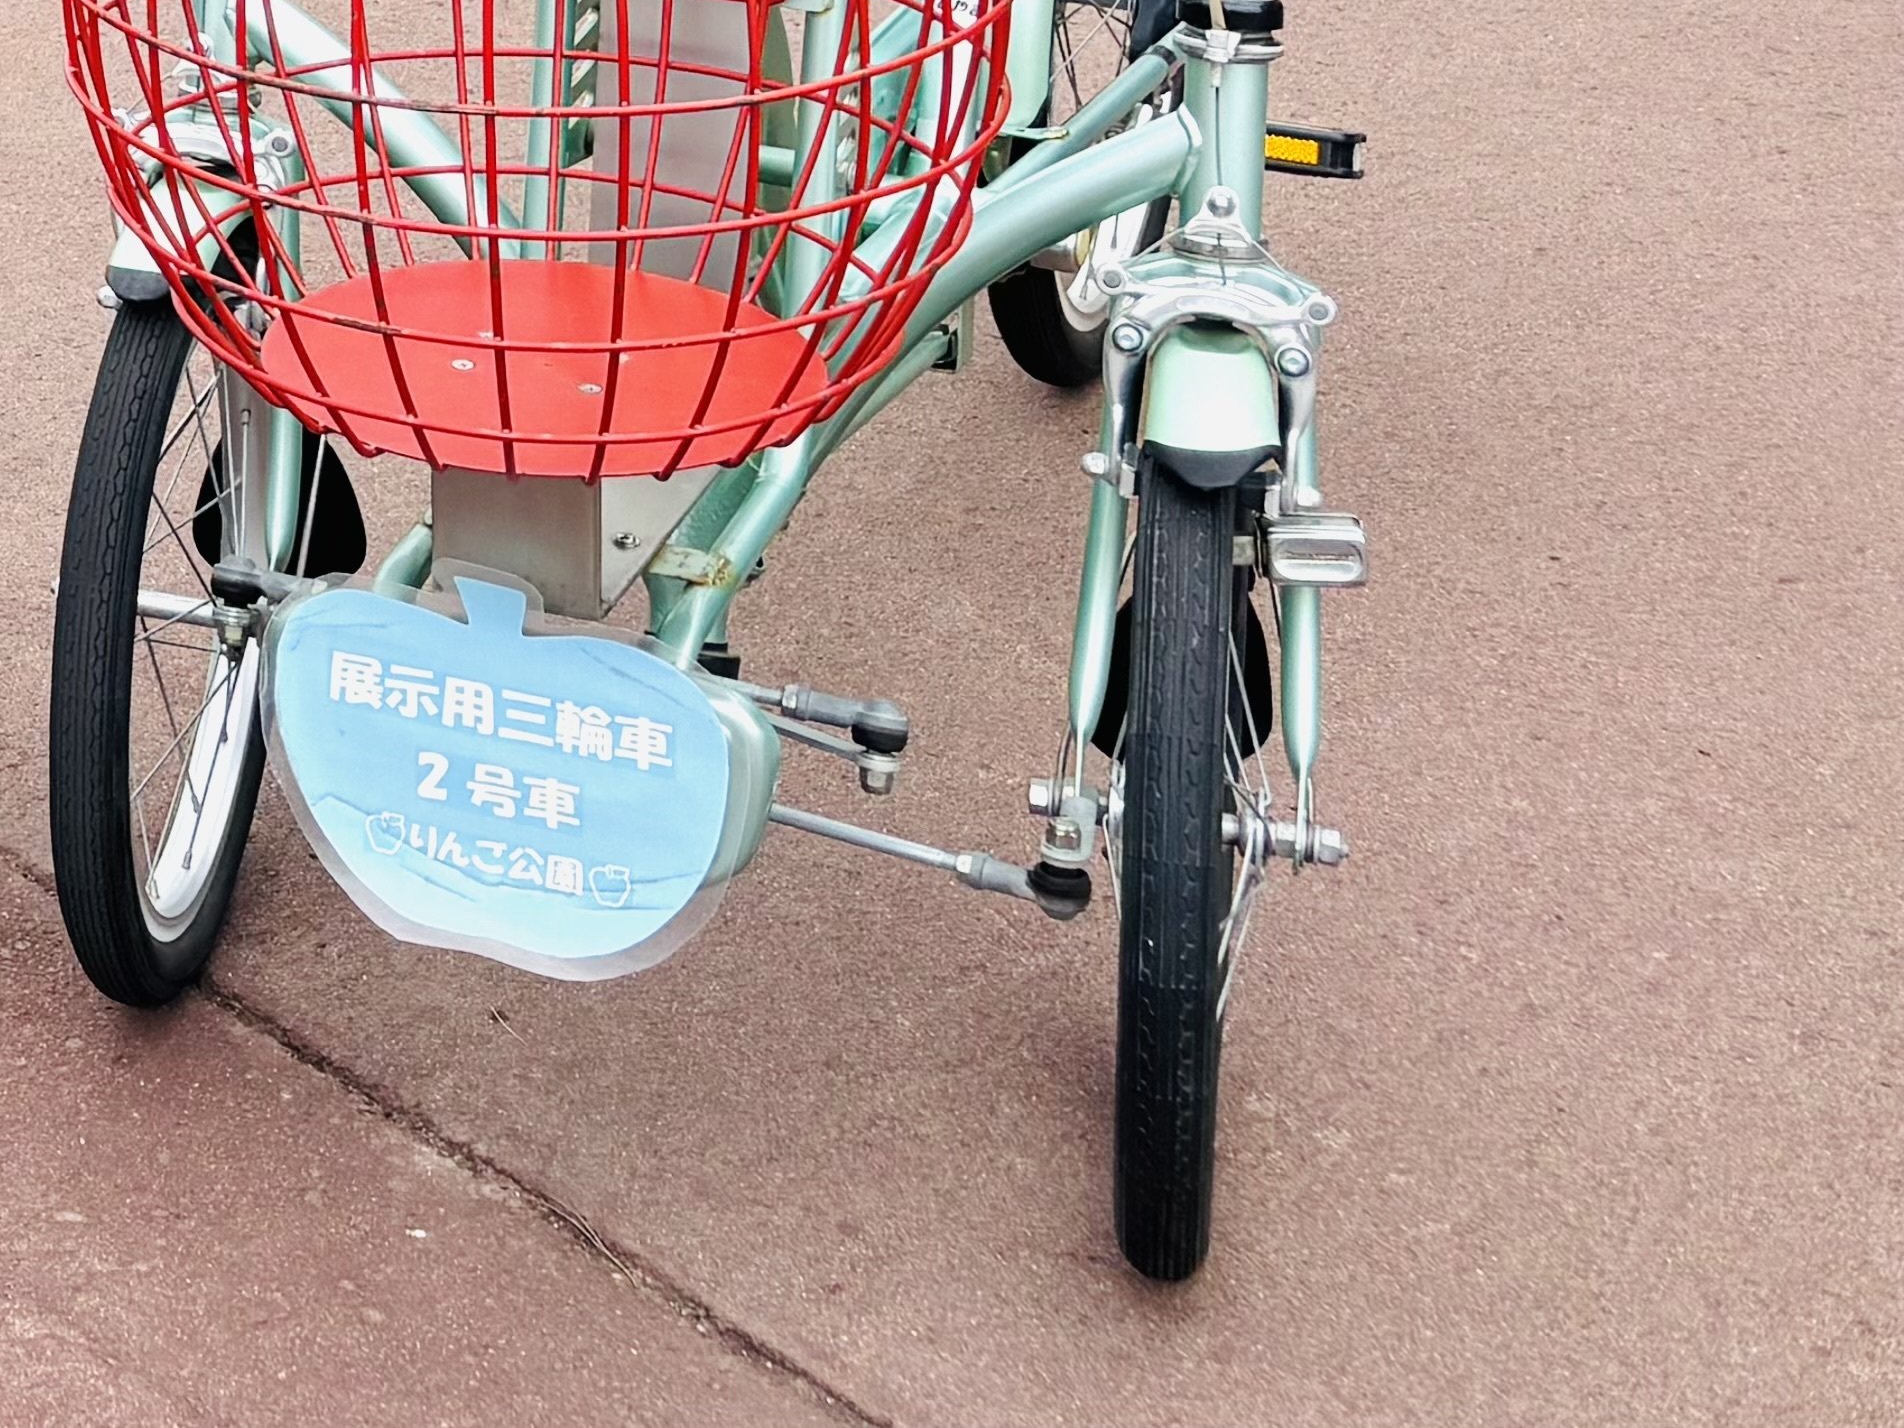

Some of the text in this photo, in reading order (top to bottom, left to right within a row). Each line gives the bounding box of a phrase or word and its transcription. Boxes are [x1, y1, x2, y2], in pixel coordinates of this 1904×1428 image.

[330, 651, 673, 770] 展示用三輪車
[410, 824, 584, 896] りんご公園
